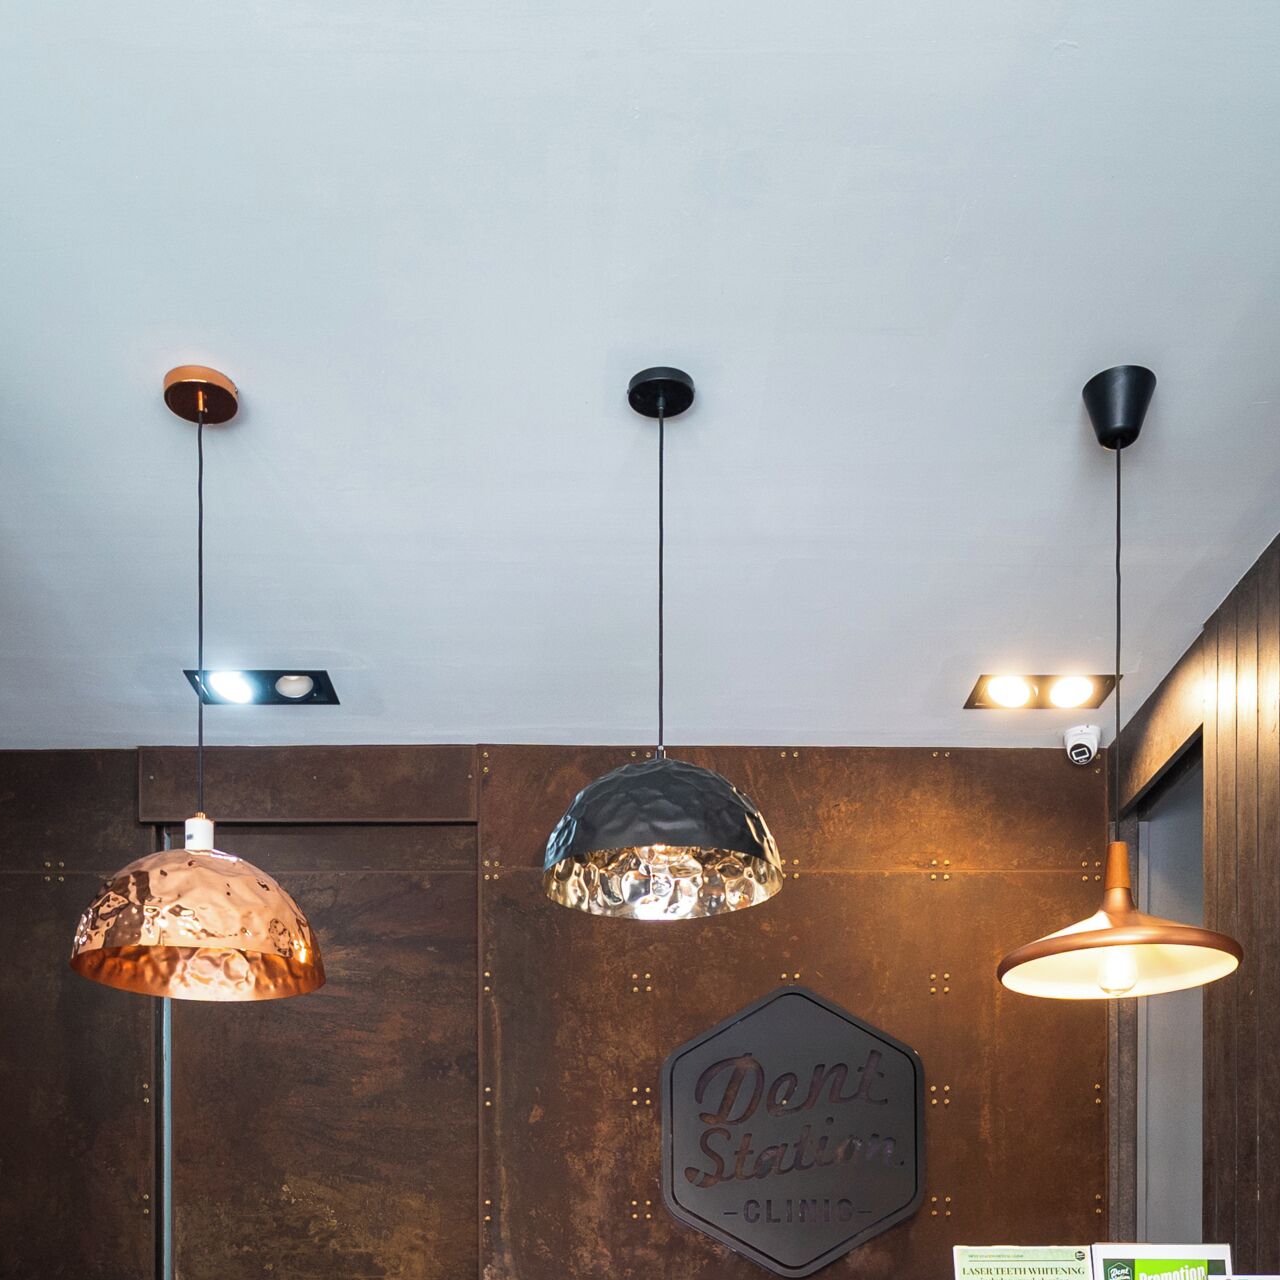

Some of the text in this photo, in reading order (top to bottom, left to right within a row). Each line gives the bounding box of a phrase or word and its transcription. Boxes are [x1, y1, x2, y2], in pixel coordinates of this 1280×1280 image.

[694, 1050, 888, 1126] Dent
[684, 1117, 905, 1188] Station
[743, 1198, 855, 1224] CLINIC
[962, 1267, 1085, 1275] LASER TEETH WHITENING
